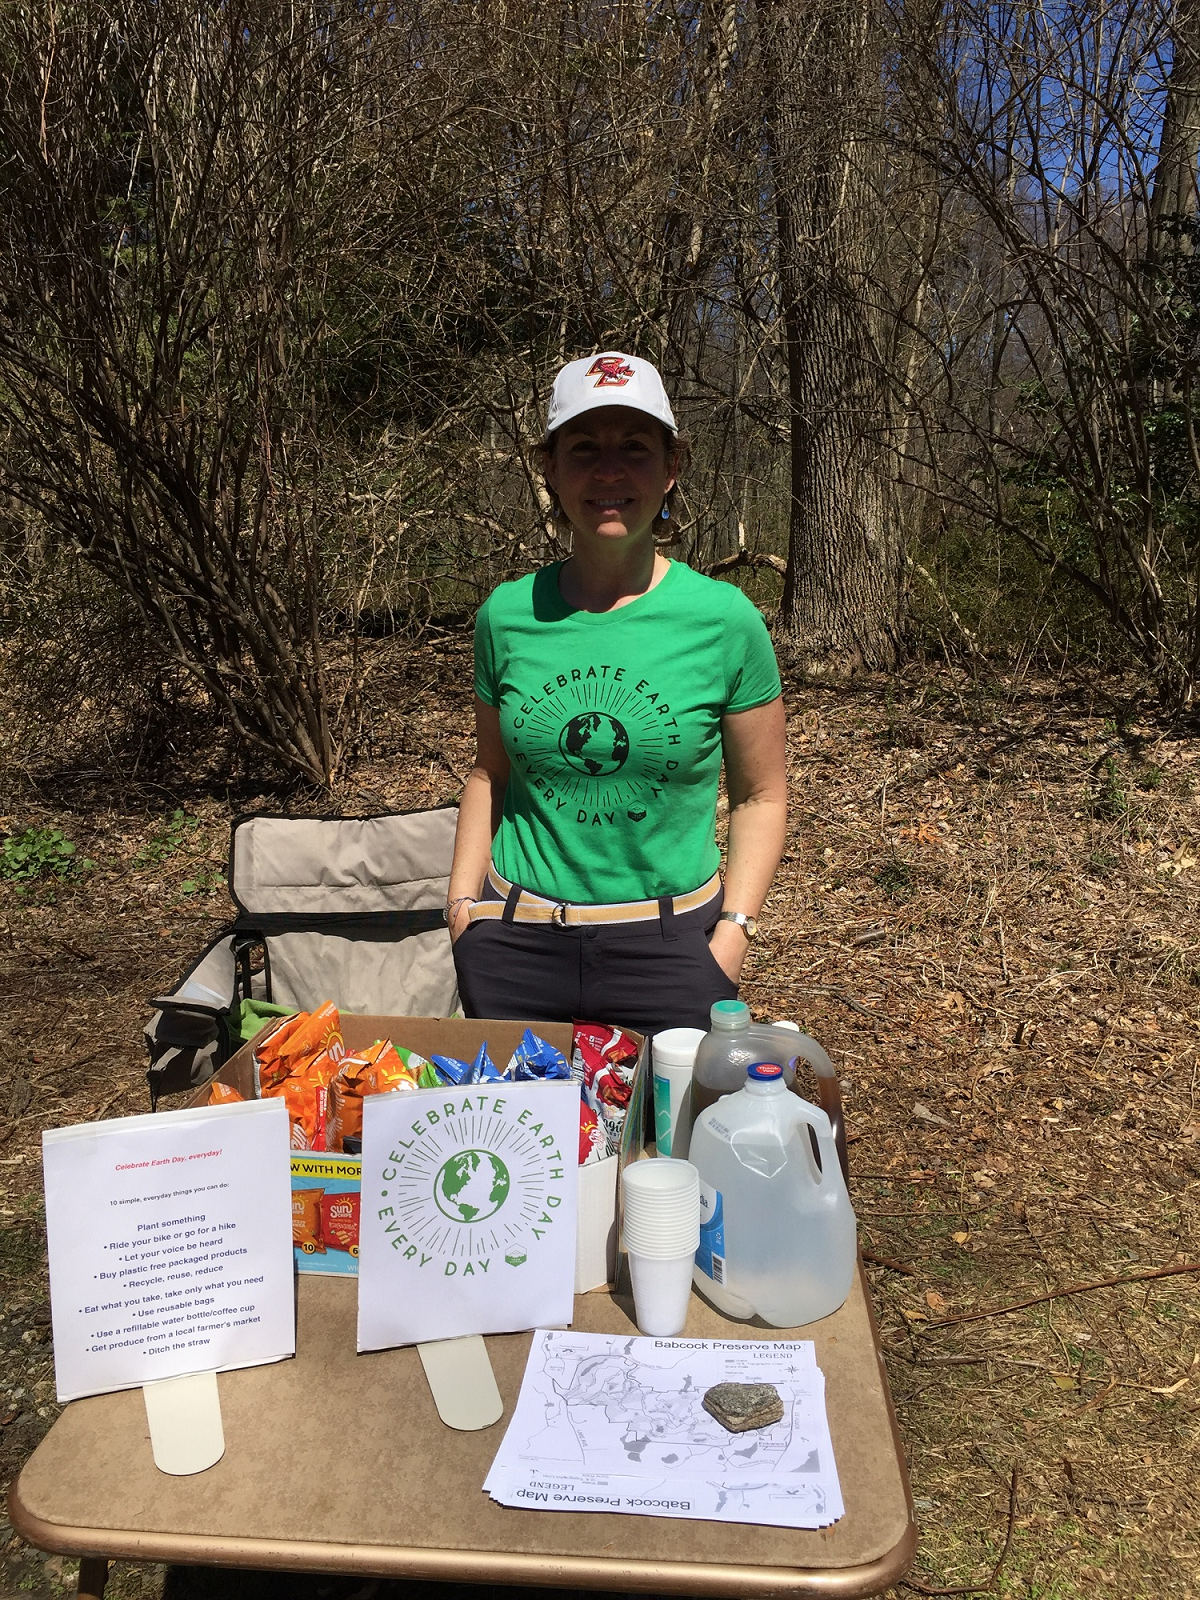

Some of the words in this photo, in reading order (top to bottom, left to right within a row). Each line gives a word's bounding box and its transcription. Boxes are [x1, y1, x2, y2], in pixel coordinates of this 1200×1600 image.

[513, 665, 626, 729] CELEBRATE
[634, 679, 681, 746] EARTH
[514, 752, 567, 811] EVERY
[576, 809, 615, 826] DAY
[649, 760, 679, 799] DAY
[382, 1096, 507, 1181] CELEBRATE
[517, 1109, 564, 1180] EARTH
[116, 1162, 149, 1170] Celebrate
[189, 1149, 222, 1160] everyday!
[302, 1164, 333, 1174] WITH
[337, 1166, 361, 1176] MOR
[330, 1205, 353, 1218] Sun
[531, 1195, 562, 1241] DAY
[138, 1222, 159, 1231] Plant
[162, 1215, 205, 1227] something
[110, 1242, 129, 1250] Ride
[132, 1239, 151, 1248] your
[185, 1230, 195, 1238] go
[141, 1251, 160, 1260] your
[162, 1246, 184, 1254] voice
[200, 1238, 222, 1248] heard
[303, 1244, 314, 1252] 10
[378, 1206, 432, 1268] EVERY
[444, 1258, 491, 1277] DAY
[120, 1266, 147, 1278] plastic
[169, 1254, 208, 1268] packaged
[211, 1248, 247, 1260] products
[129, 1277, 164, 1288] Recycle,
[168, 1272, 192, 1280] reuse,
[195, 1266, 223, 1275] reduce
[101, 1302, 122, 1310] what
[124, 1299, 140, 1308] you
[165, 1290, 182, 1298] take
[185, 1286, 202, 1294] only
[205, 1282, 224, 1290] what
[227, 1280, 242, 1288] you
[244, 1276, 263, 1284] need
[157, 1302, 192, 1313] reusable
[124, 1322, 159, 1333] refillable
[162, 1317, 184, 1325] water
[187, 1308, 237, 1320] bottle/coffee
[92, 1344, 106, 1352] Get
[109, 1338, 144, 1350] produce
[147, 1334, 166, 1342] from
[176, 1326, 195, 1336] local
[198, 1322, 230, 1331] farmer's
[234, 1316, 260, 1326] market
[149, 1346, 170, 1355] Ditch
[654, 1341, 709, 1350] Babcock
[713, 1342, 770, 1350] Preserve
[773, 1343, 801, 1351] Map
[516, 1489, 549, 1502] Map
[529, 1481, 574, 1491] LEGEND
[553, 1492, 621, 1507] Preserve
[626, 1497, 691, 1511] Babcock
